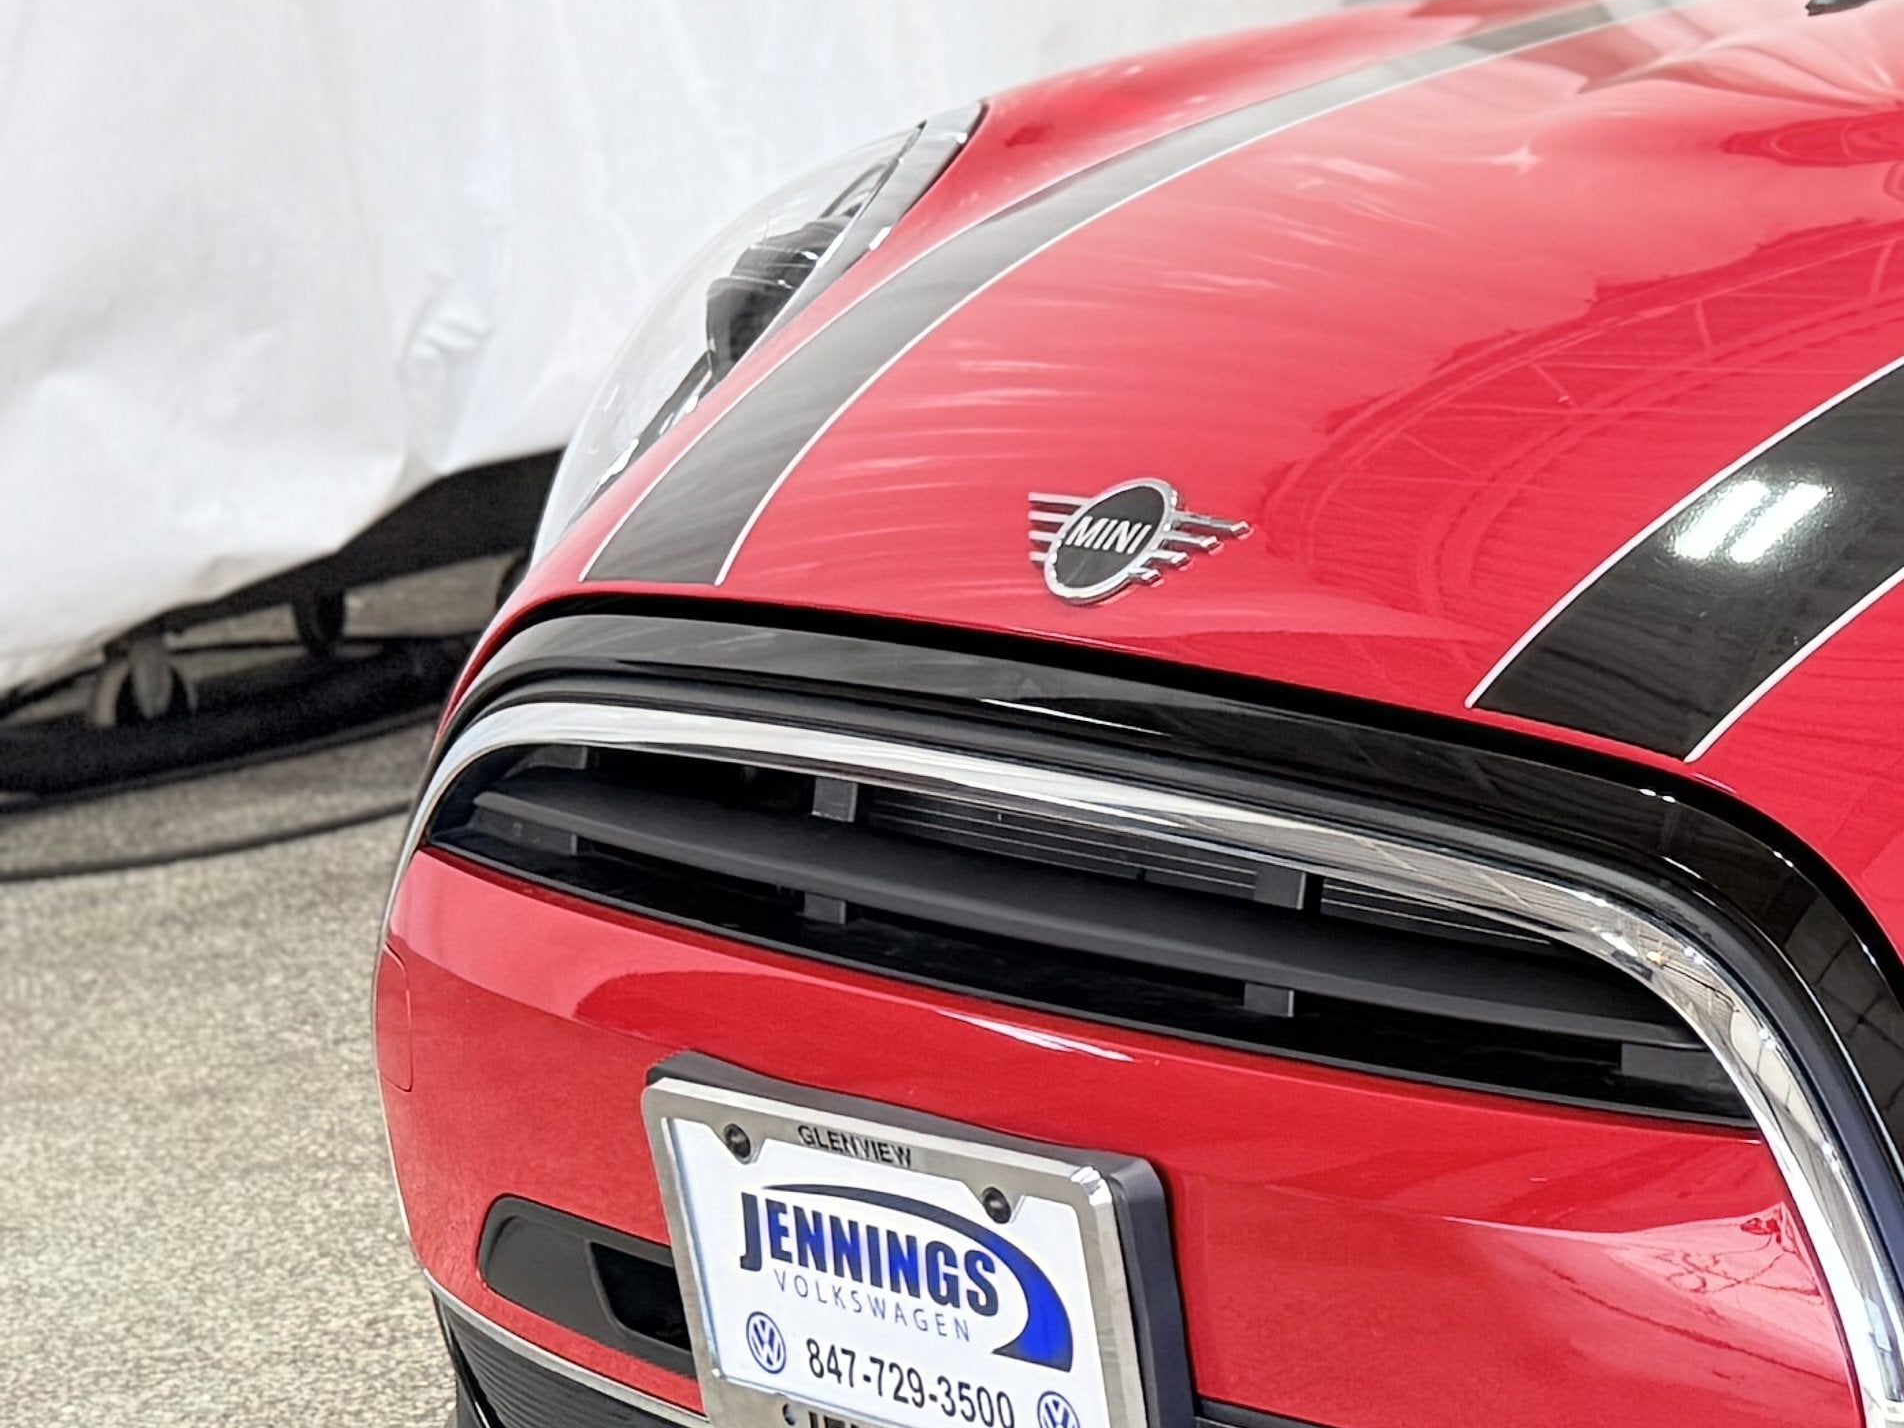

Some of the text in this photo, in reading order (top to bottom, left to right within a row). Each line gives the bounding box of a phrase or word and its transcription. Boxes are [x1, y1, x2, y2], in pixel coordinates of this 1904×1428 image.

[1065, 515, 1152, 555] MINI
[797, 1124, 912, 1169] GLENVIEW
[739, 1191, 1000, 1317] JENNINGS
[772, 1268, 971, 1343] VOLKSWAGEN
